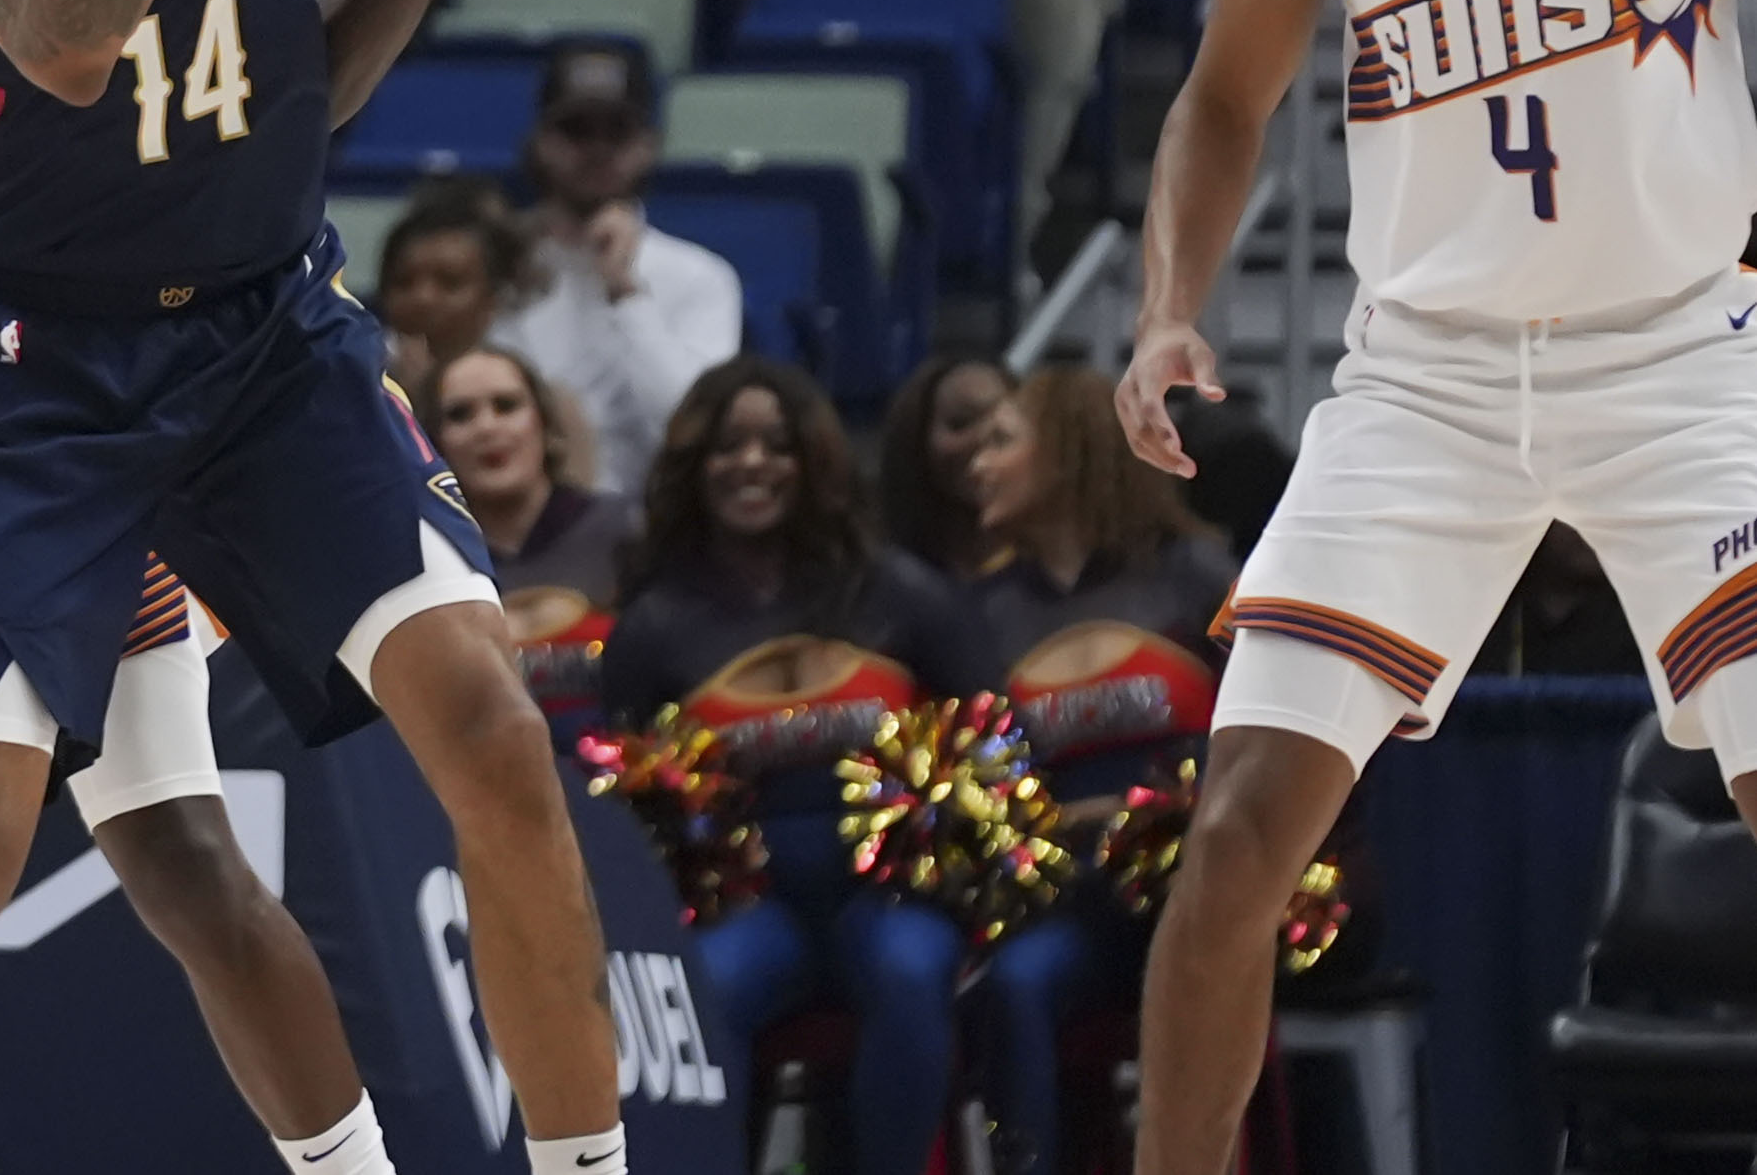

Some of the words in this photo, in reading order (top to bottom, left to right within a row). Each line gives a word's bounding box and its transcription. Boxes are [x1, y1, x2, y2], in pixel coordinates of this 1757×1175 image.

[1483, 94, 1560, 224] 4
[1712, 516, 1757, 573] PH
[607, 950, 727, 1106] DUEL
